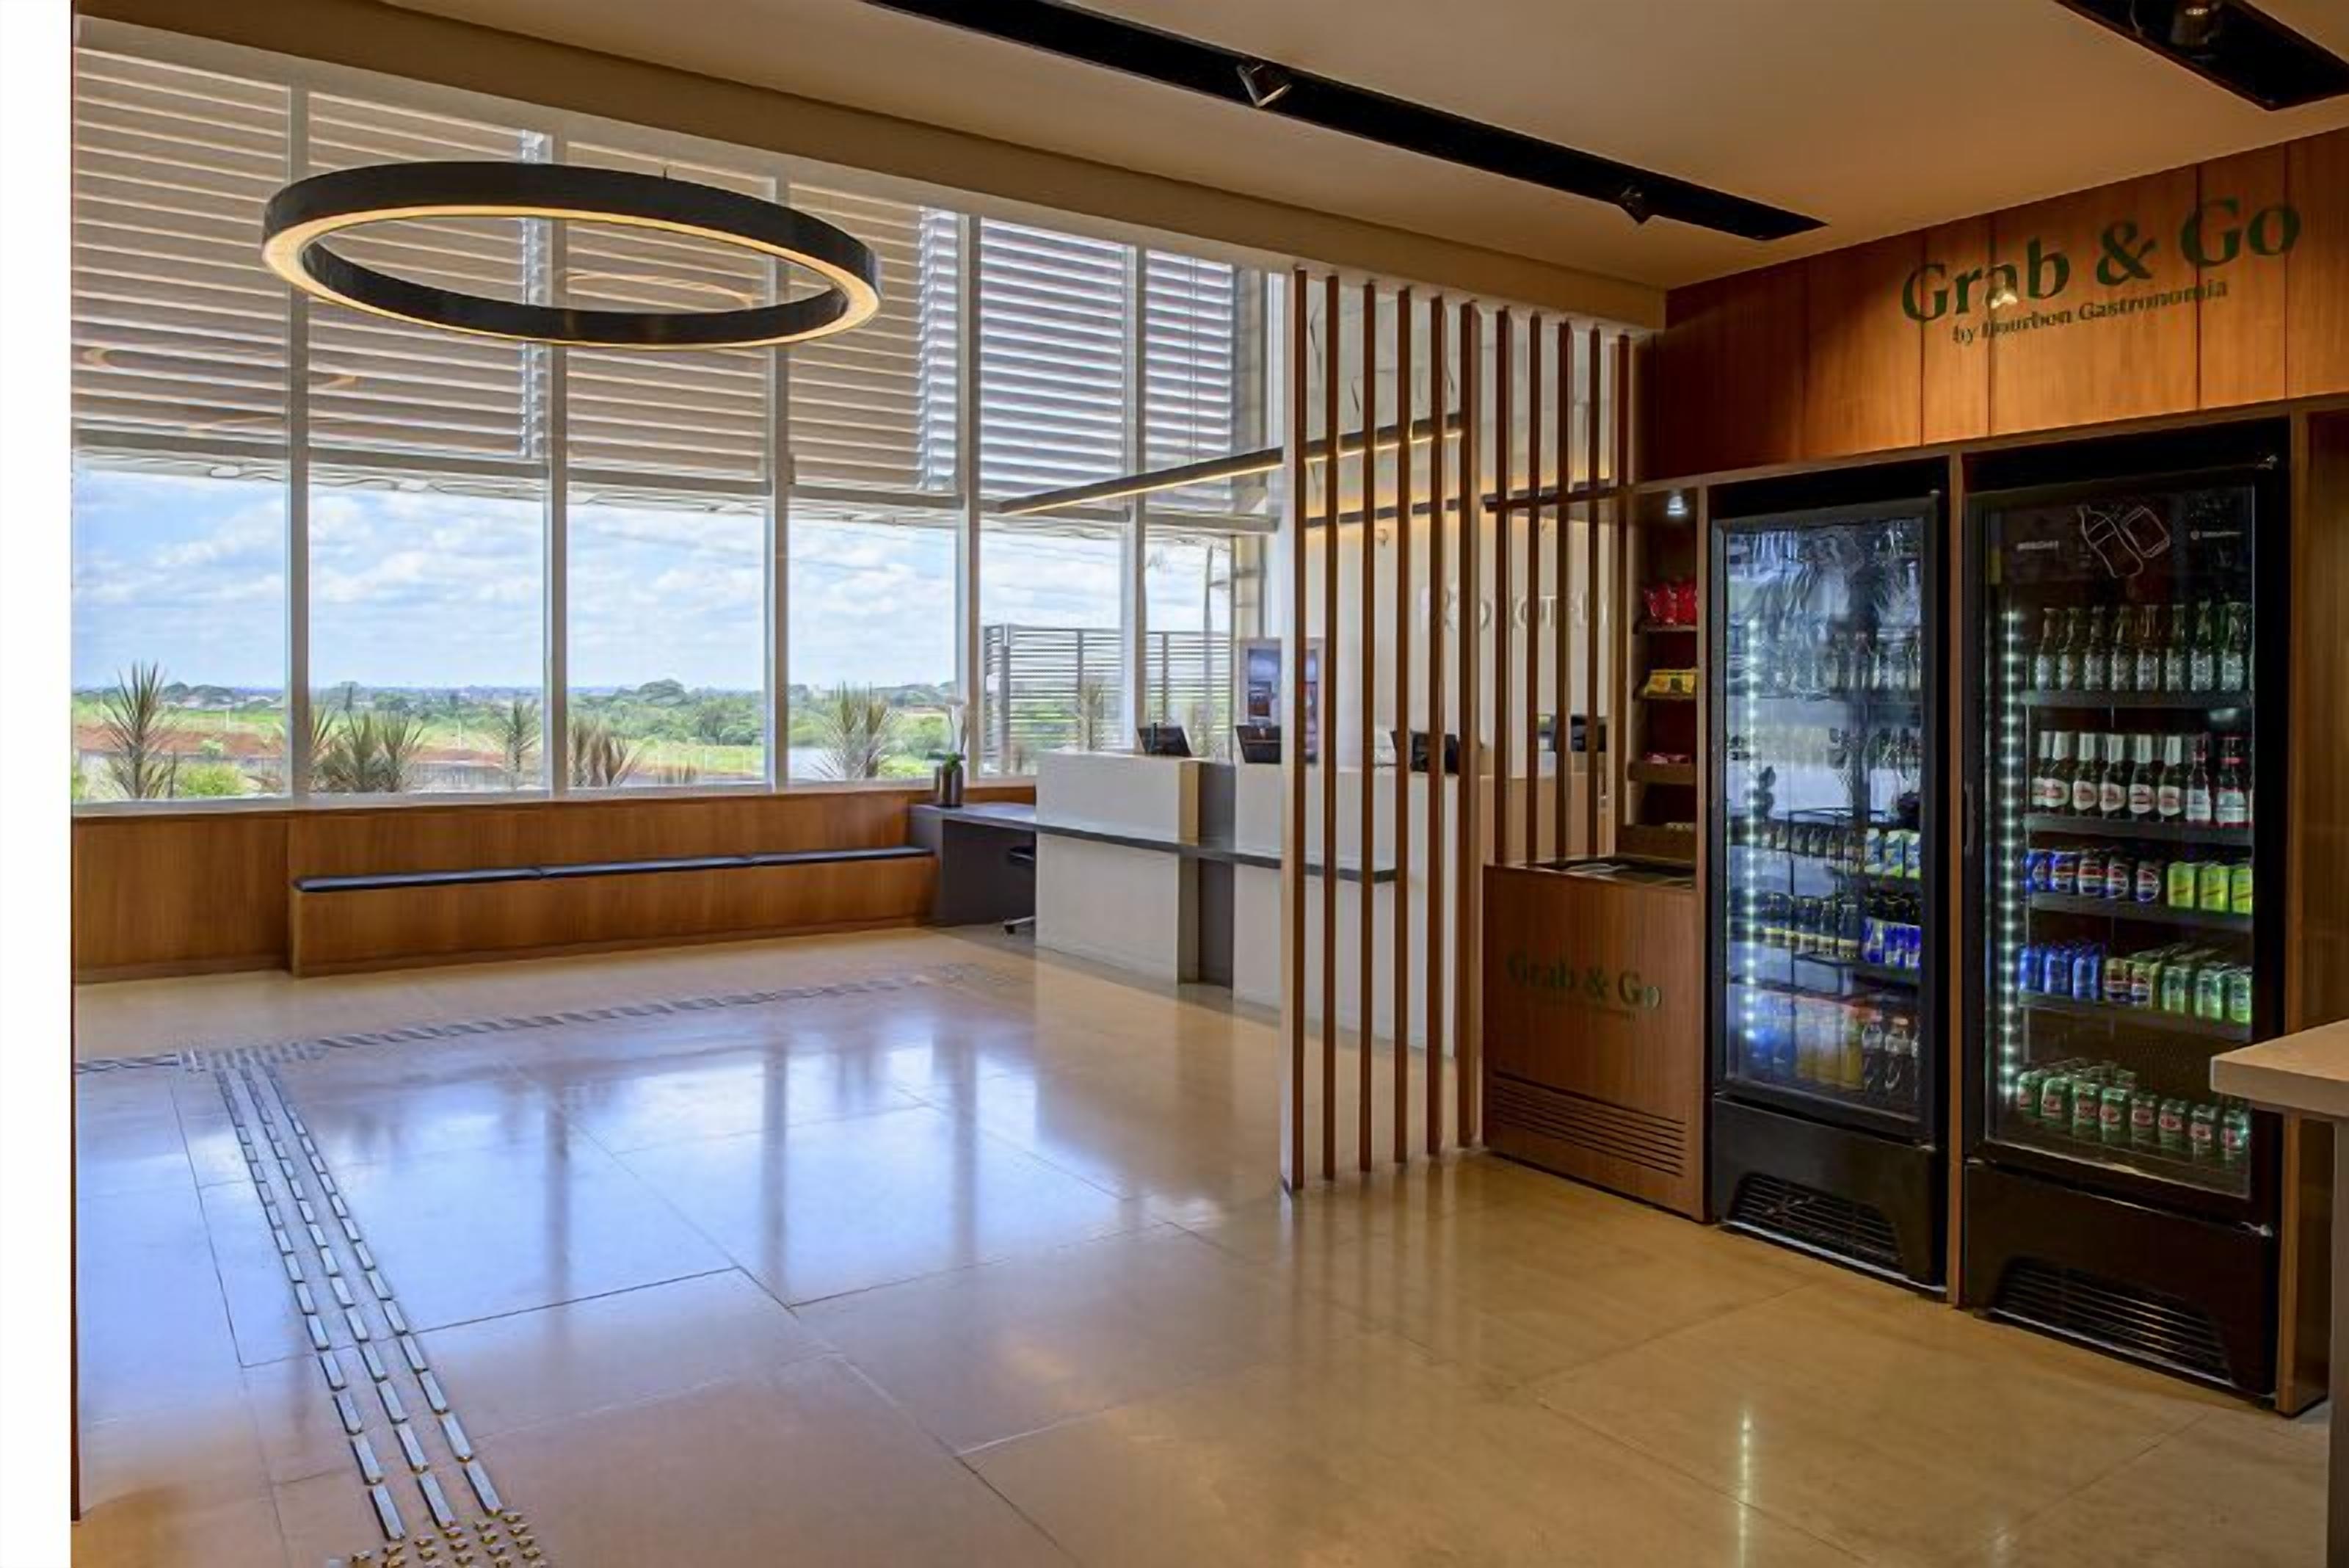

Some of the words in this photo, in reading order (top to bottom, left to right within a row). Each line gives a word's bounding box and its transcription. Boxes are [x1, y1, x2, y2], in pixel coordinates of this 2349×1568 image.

[1901, 236, 2071, 324] Grab
[2095, 219, 2157, 287] &
[2179, 197, 2302, 269] Go
[1952, 324, 1975, 346] by
[1618, 969, 1663, 1010] Go
